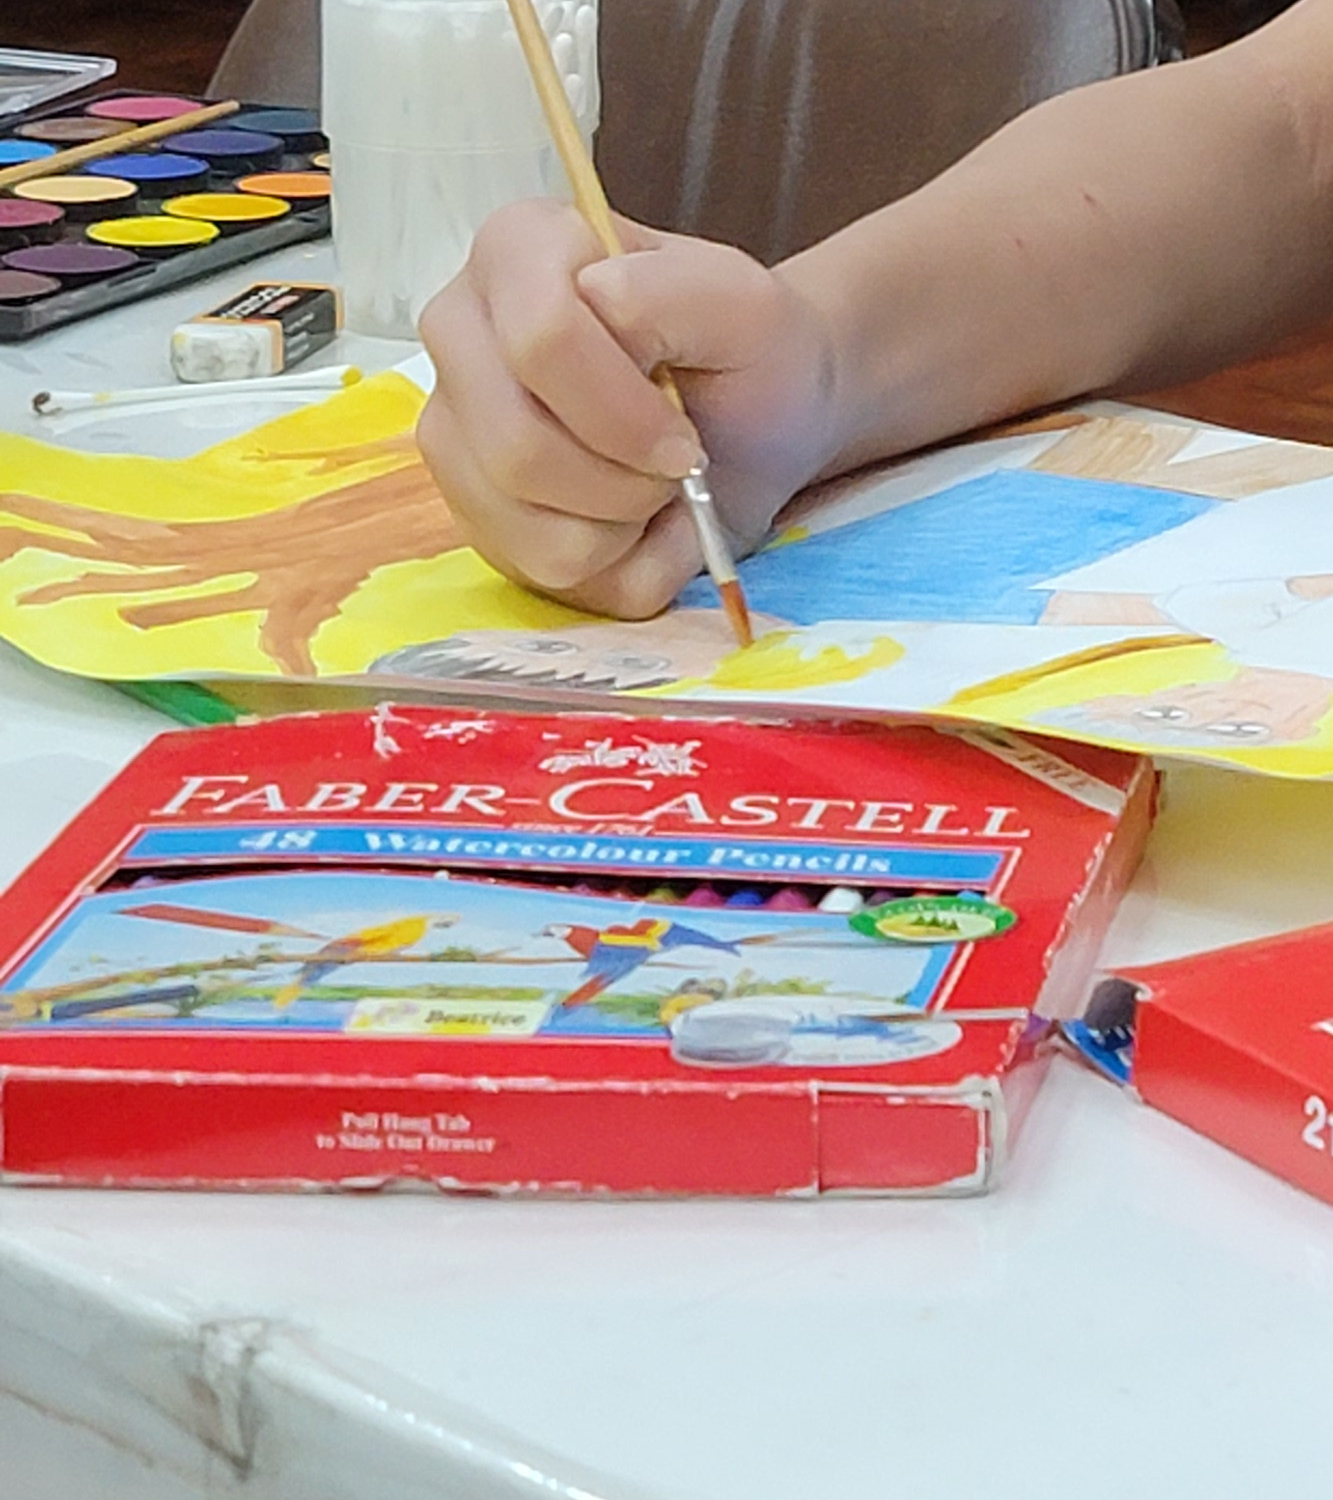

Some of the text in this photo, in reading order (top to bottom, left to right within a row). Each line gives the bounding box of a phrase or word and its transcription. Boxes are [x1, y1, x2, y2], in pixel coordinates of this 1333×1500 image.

[149, 774, 1031, 838] FABER-CASTELL
[238, 829, 893, 875] 48 Watercolour Pencils
